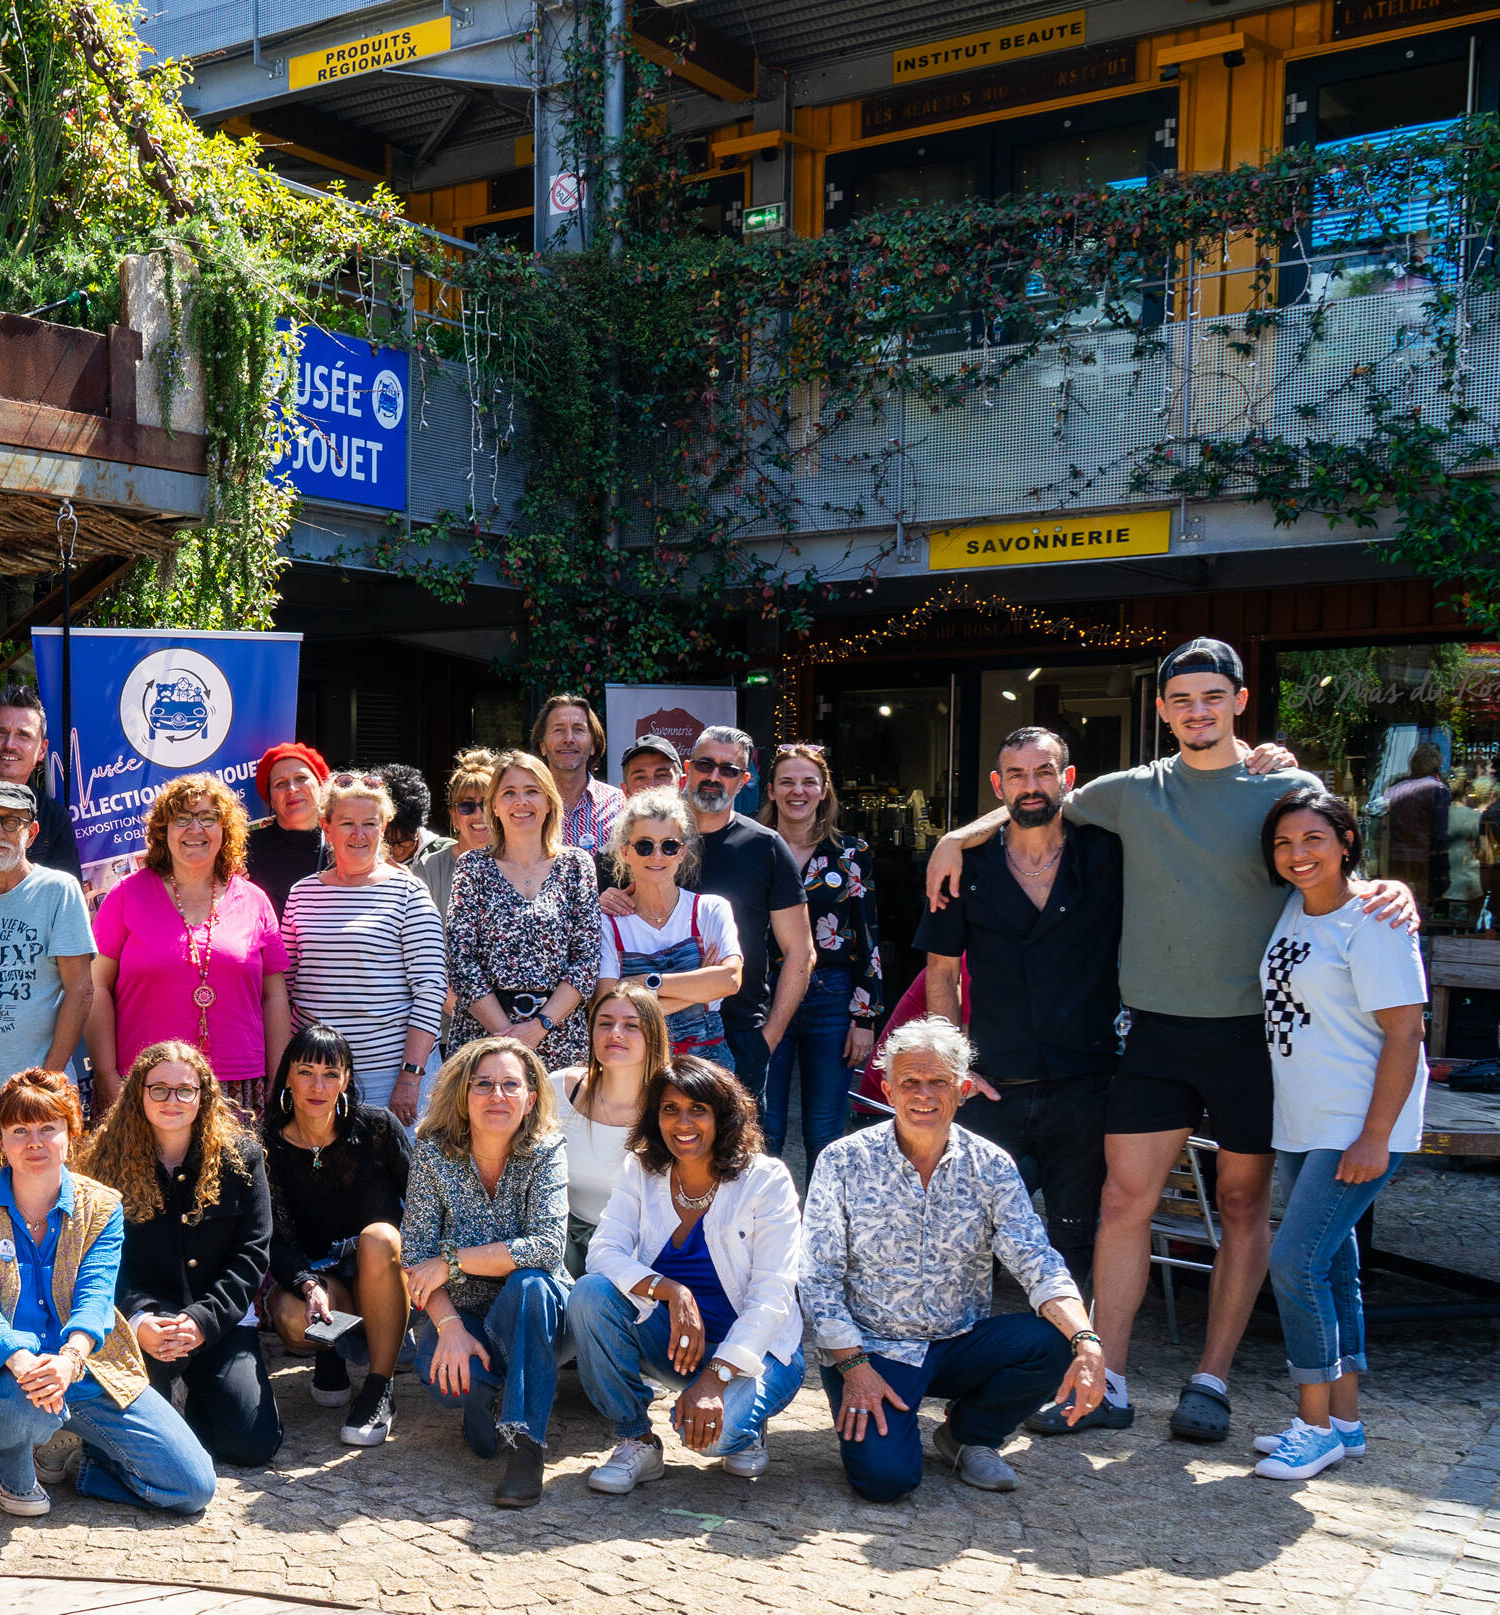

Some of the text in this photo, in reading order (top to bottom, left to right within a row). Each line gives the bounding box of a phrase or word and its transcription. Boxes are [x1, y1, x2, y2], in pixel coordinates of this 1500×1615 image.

[317, 45, 418, 82] REGIONAUX
[325, 32, 411, 65] PRODUITS
[896, 22, 1084, 73] INSTITUT BEAUTE
[268, 354, 364, 418] USÉE
[292, 428, 384, 484] JOUET
[966, 528, 1131, 555] SAVONNERIE
[1287, 674, 1326, 712] Le
[1334, 667, 1405, 709] Mas
[1410, 668, 1447, 703] du
[649, 720, 693, 736] Savonnerie
[74, 816, 143, 839] EXPOSITION
[113, 834, 127, 844] &
